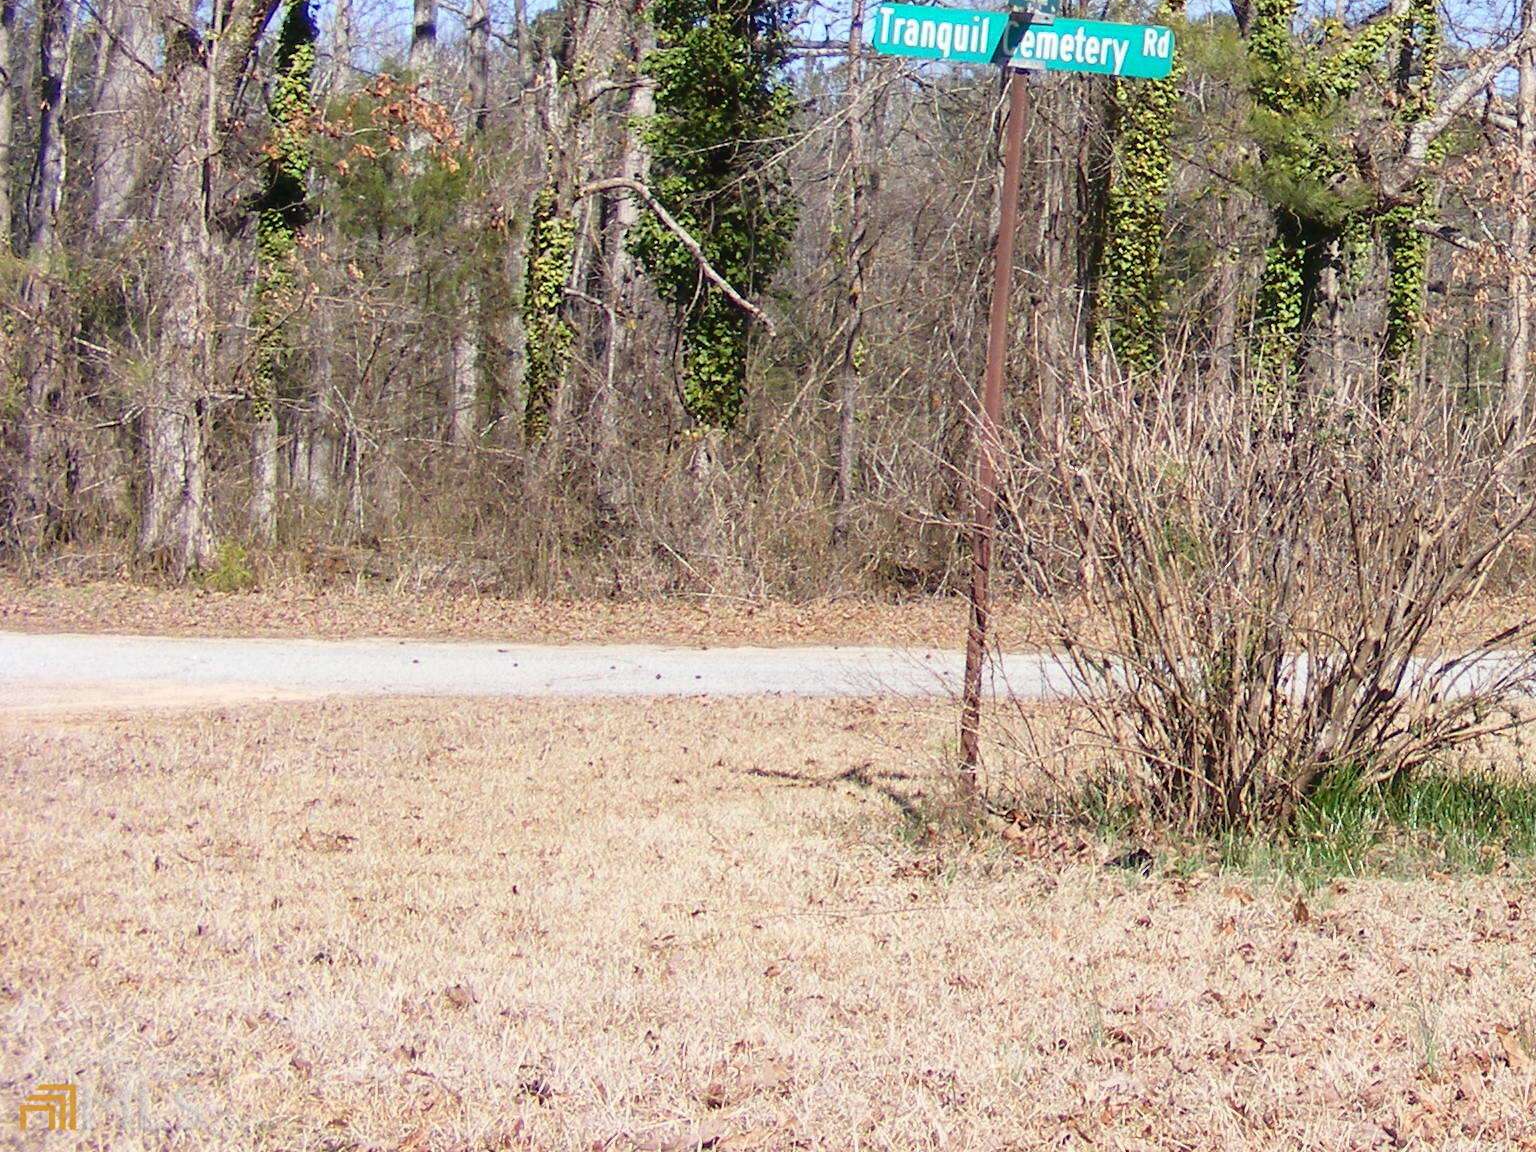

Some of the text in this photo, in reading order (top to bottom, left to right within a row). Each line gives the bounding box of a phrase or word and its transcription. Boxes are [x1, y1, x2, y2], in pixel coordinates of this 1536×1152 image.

[880, 6, 1171, 75] Tranquil Cemetery Rd
